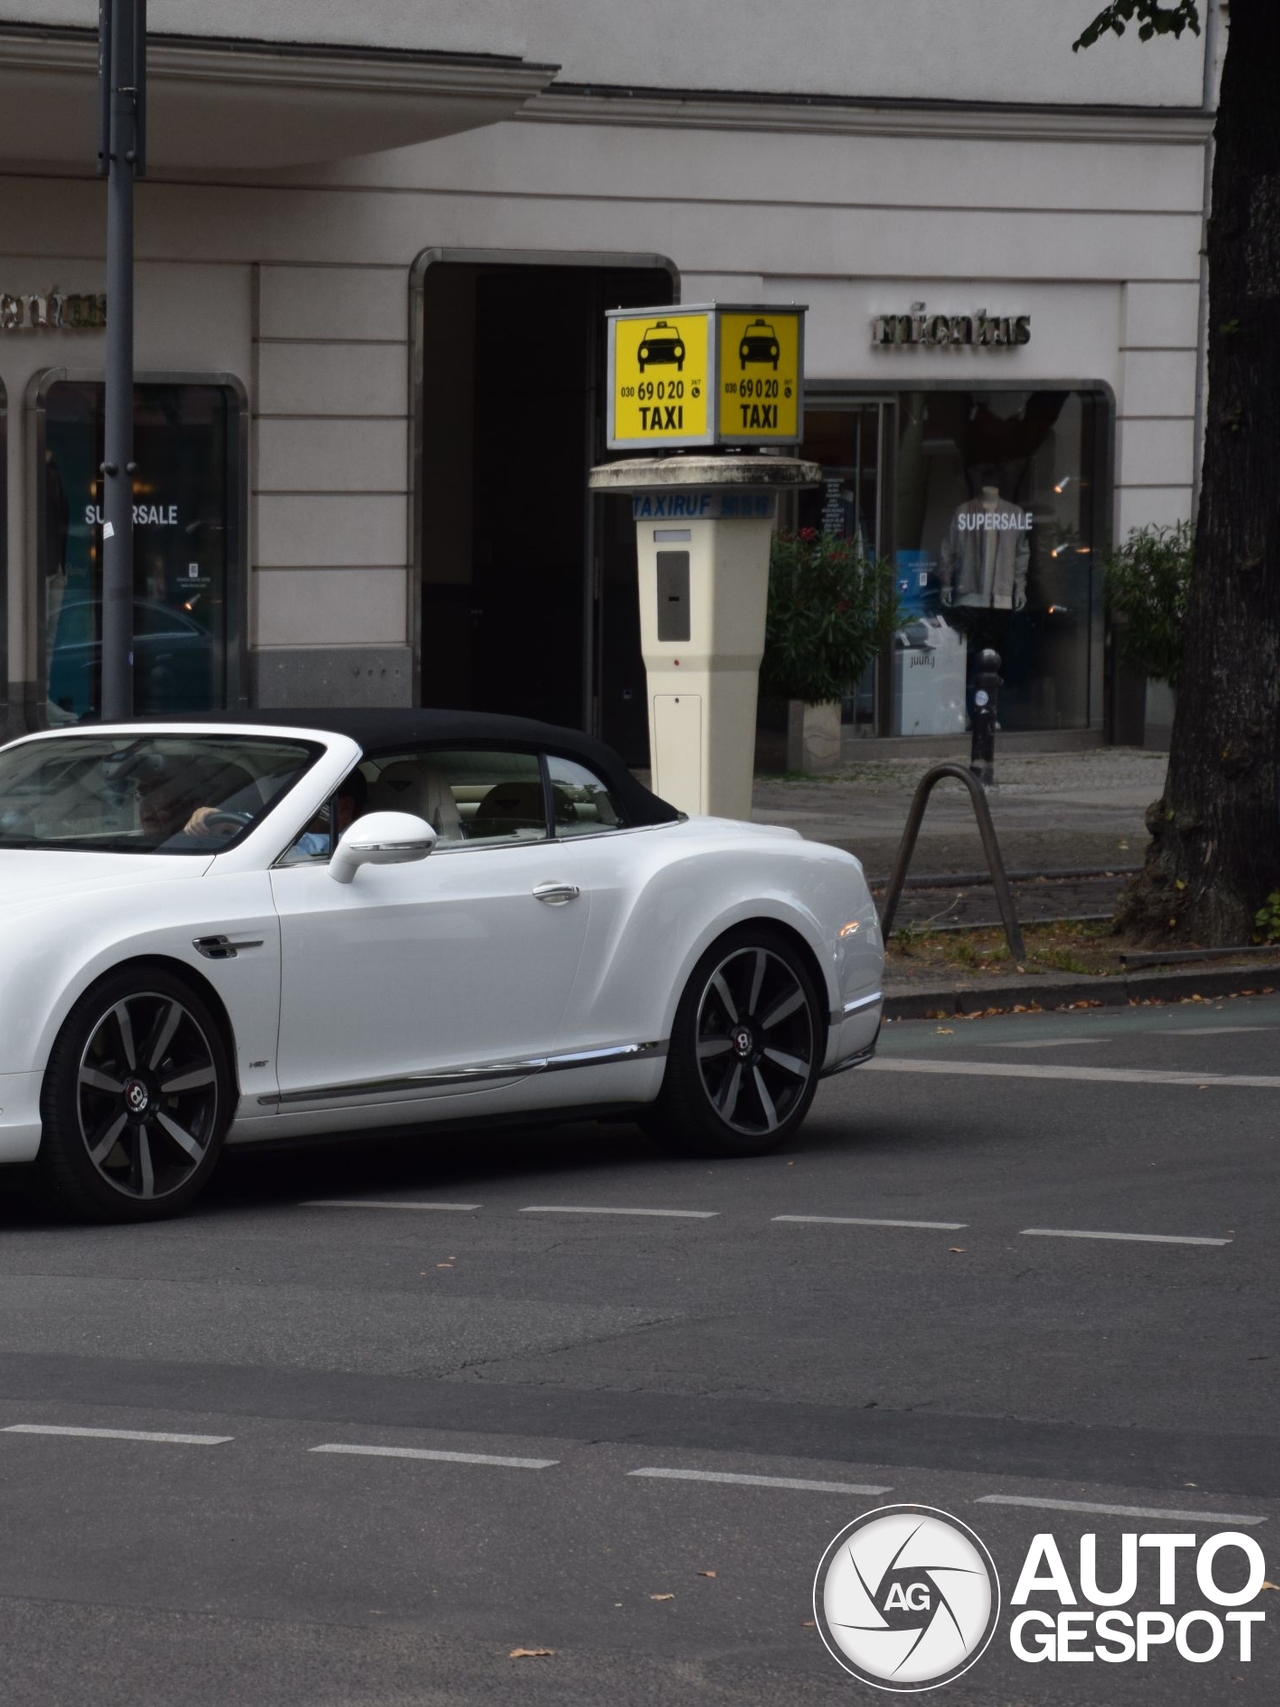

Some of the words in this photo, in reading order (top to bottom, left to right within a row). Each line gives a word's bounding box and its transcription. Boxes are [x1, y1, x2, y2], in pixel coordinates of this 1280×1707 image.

[873, 301, 1032, 346] mientus
[621, 386, 635, 398] 030
[724, 382, 738, 394] 030
[638, 405, 684, 431] TAXI
[740, 403, 778, 429] TAXI
[632, 493, 713, 517] TAXIRUF
[957, 512, 1033, 531] SUPERSALE
